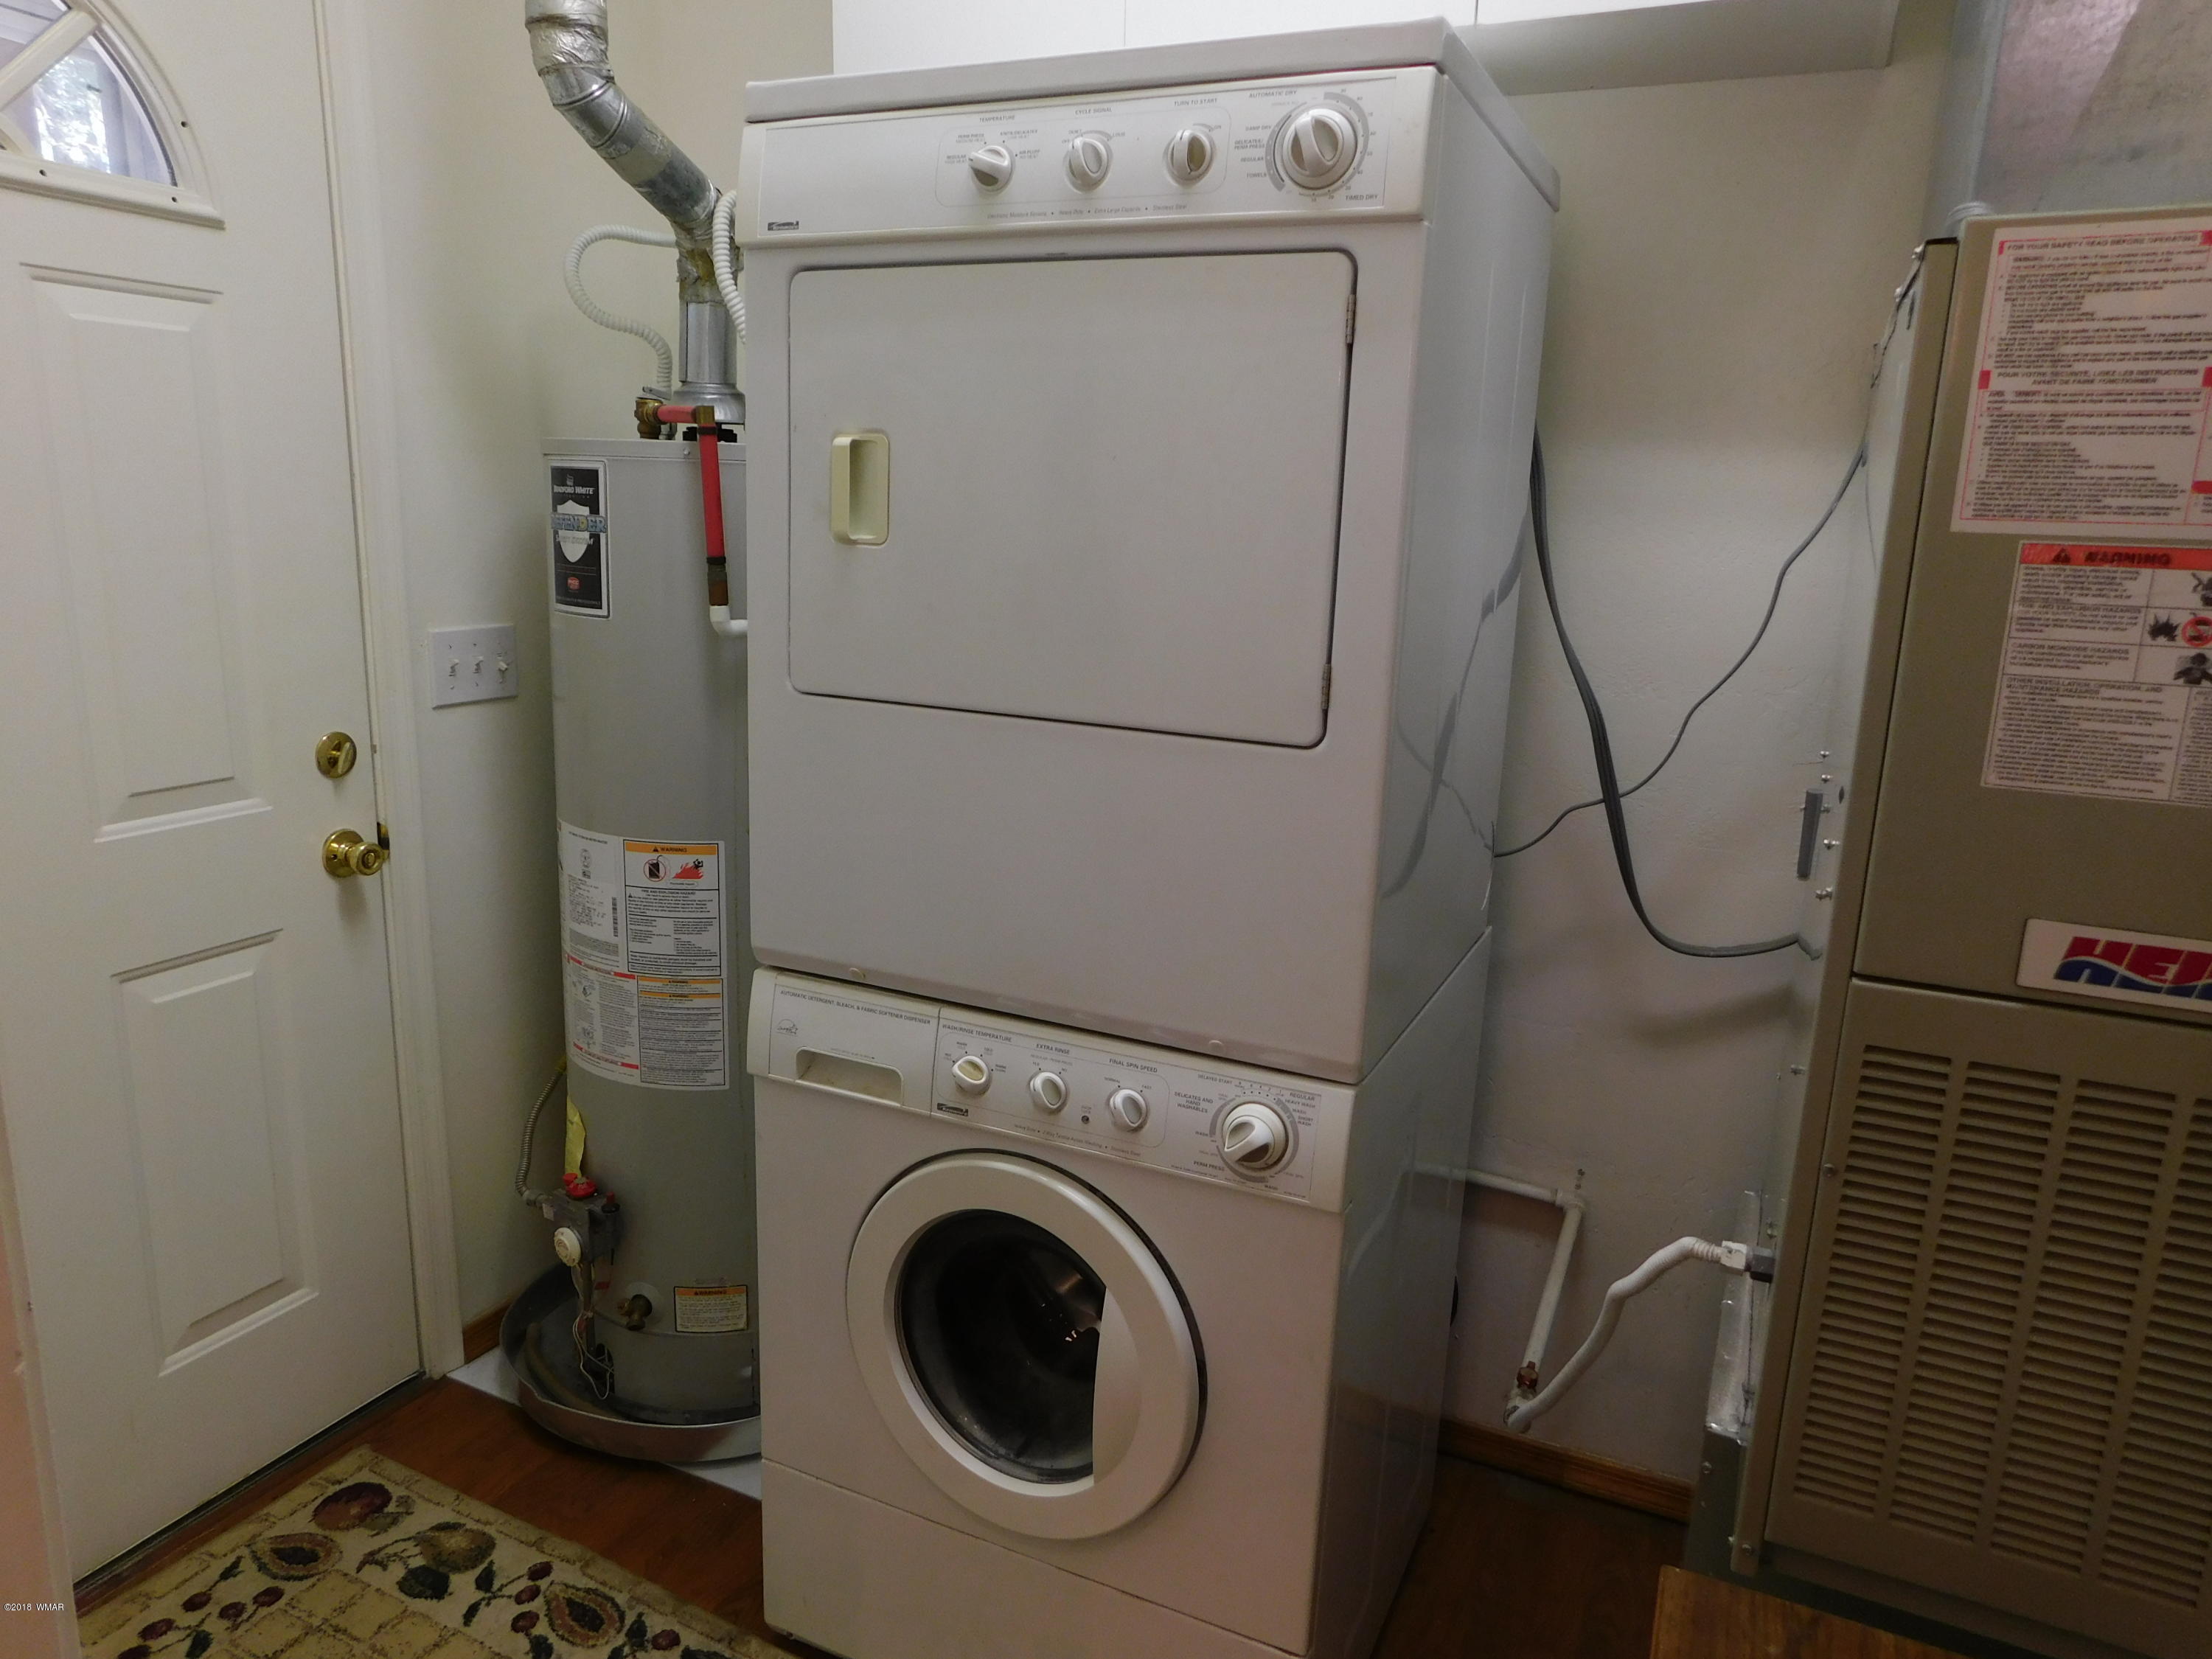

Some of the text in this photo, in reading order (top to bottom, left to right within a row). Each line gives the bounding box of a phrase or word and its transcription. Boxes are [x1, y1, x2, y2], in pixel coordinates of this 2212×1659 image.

[979, 114, 1015, 123] TEMPERATURE
[2027, 242, 2049, 250] YOUR
[575, 486, 594, 494] WHITE
[2084, 551, 2173, 566] WARNING
[2054, 936, 2212, 1001] HEI
[780, 990, 807, 1001] AUTOMATIC
[861, 1006, 877, 1015] FABRIC
[878, 1009, 903, 1020] SOFTENER
[903, 1015, 931, 1025] DISPENSER
[942, 1024, 1012, 1043] WASH/RINSE TEMPERATURE
[1036, 1043, 1071, 1055] EXTRA RINSE
[1109, 1058, 1158, 1073] FINAL SPIN SPEED
[1218, 1077, 1233, 1085] START
[1174, 1091, 1202, 1102] DELICATES
[1290, 1093, 1315, 1101] REGULAR
[1177, 1102, 1208, 1114] WASHABLES
[1186, 1099, 1200, 1107] HAND
